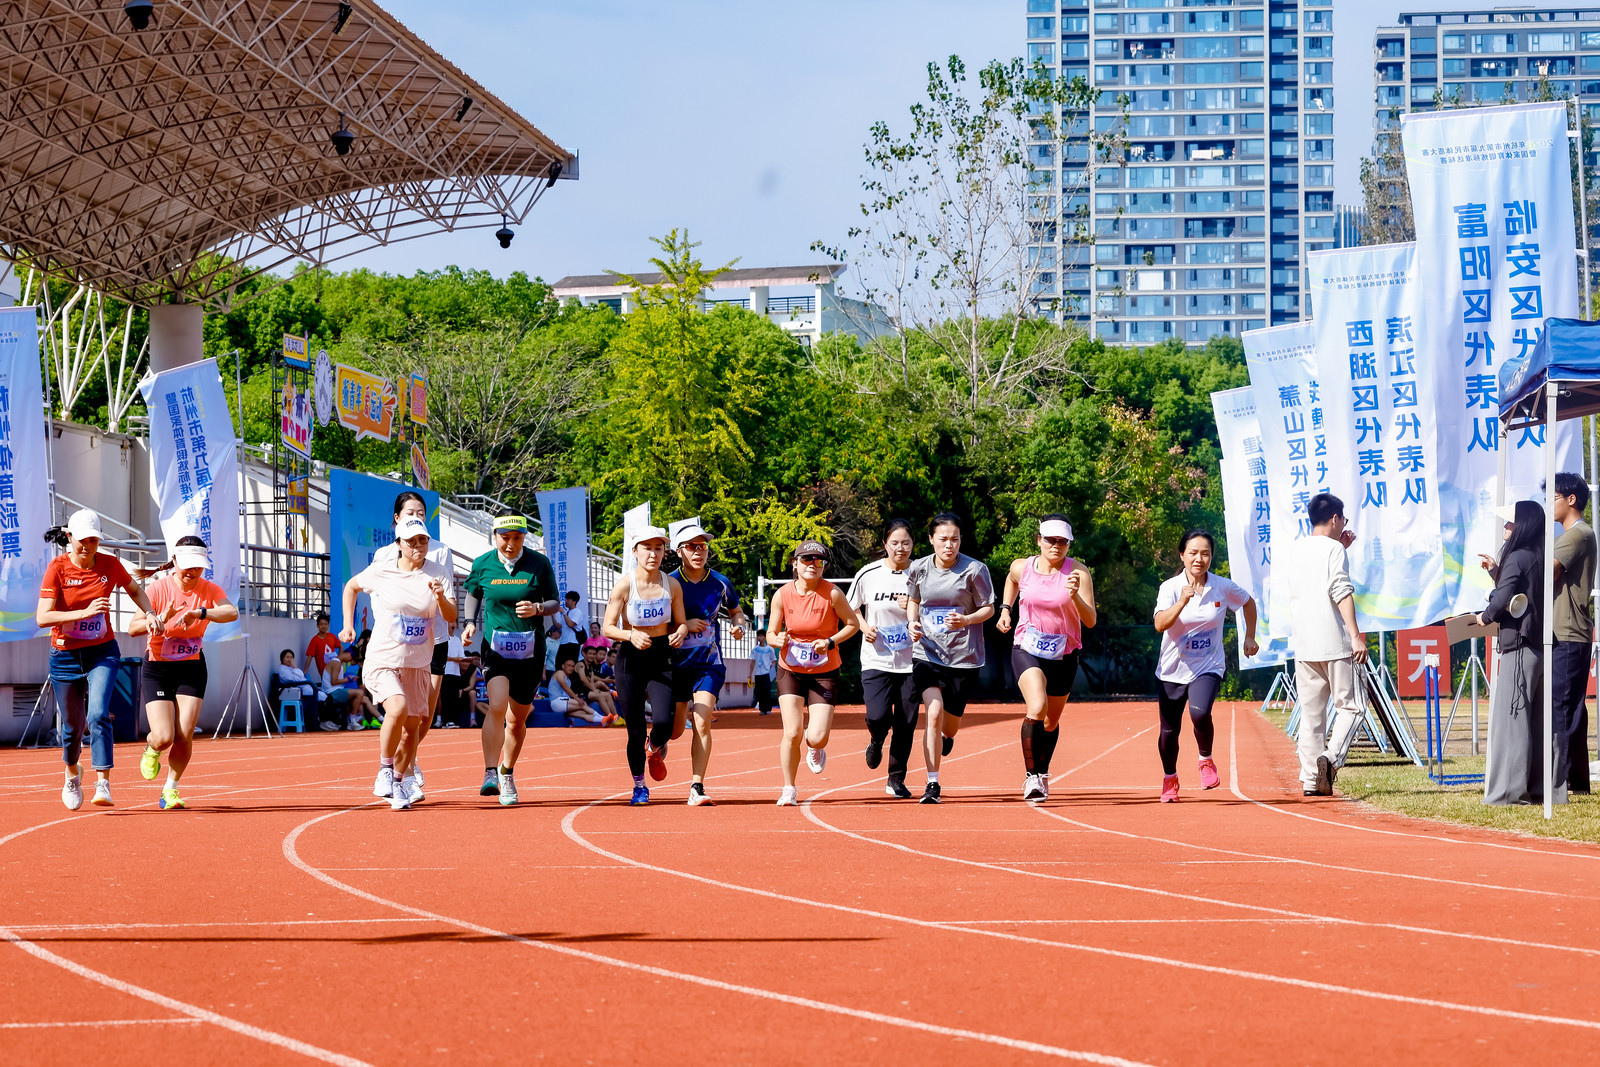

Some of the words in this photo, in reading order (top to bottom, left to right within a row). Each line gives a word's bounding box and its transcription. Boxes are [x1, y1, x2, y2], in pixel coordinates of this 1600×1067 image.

[874, 592, 909, 601] LI-N
[643, 607, 665, 619] B04
[79, 621, 101, 632] B60
[405, 626, 426, 637] B35
[887, 632, 907, 644] B24
[177, 644, 198, 654] B36
[505, 641, 527, 651] B05
[1036, 640, 1057, 652] B23
[1191, 638, 1211, 650] B29
[1407, 639, 1442, 683] 天
